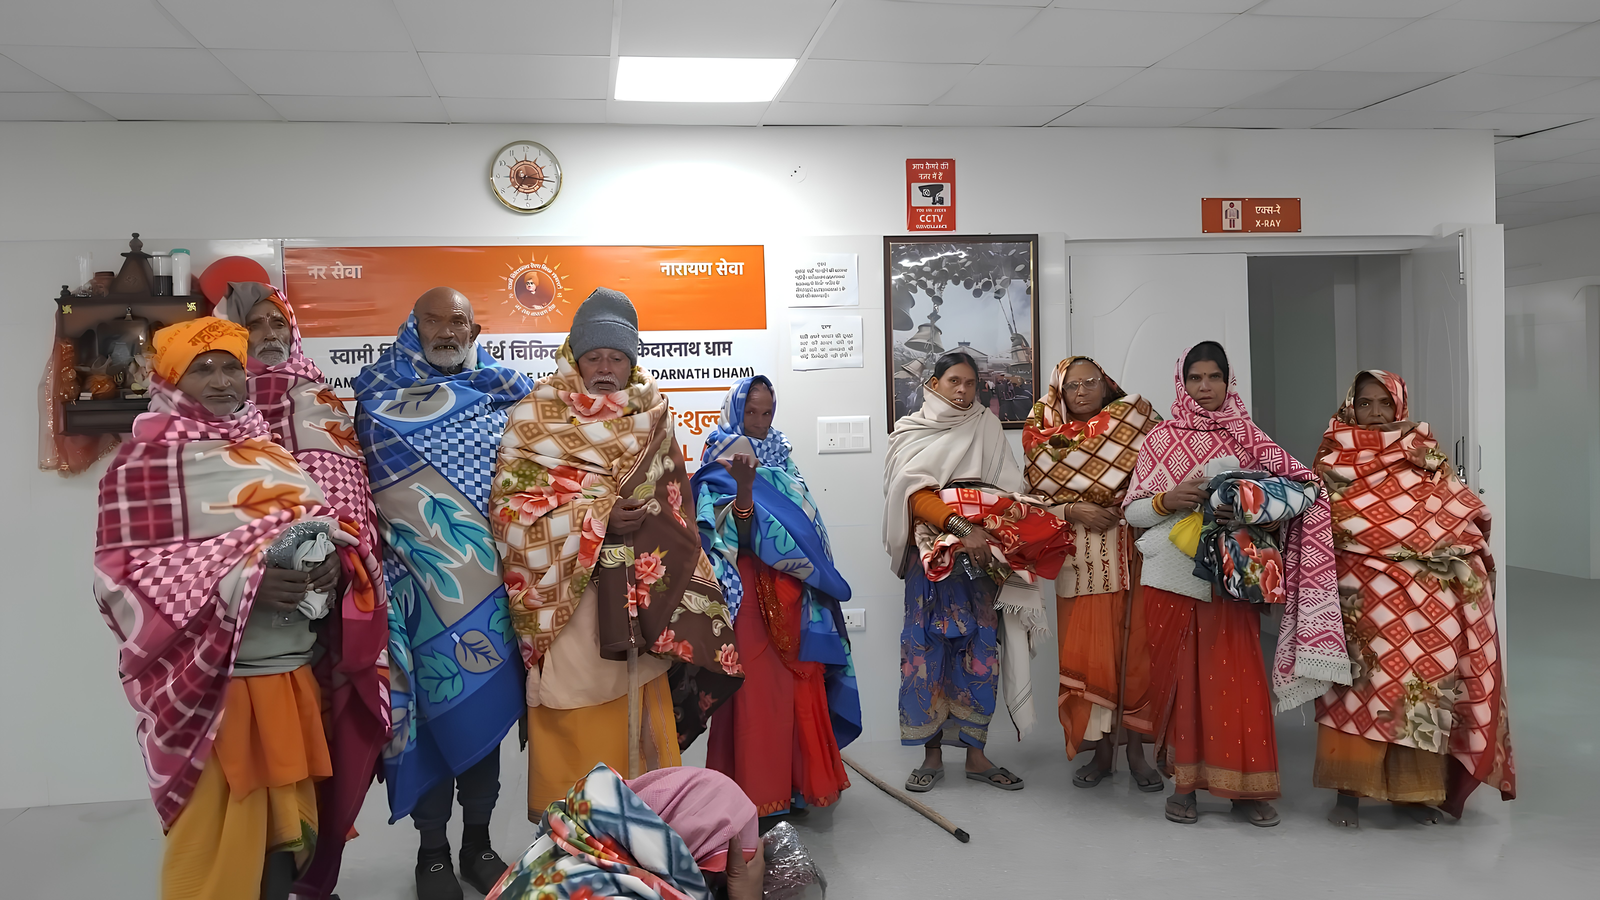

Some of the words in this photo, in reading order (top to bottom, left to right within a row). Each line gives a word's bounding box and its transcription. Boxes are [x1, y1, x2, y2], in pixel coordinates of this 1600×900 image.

[940, 162, 949, 170] की
[1255, 204, 1281, 214] एक्स-रे
[919, 214, 944, 223] CCTV
[1255, 219, 1281, 227] X-RAY
[307, 265, 328, 279] नर
[330, 261, 363, 279] सेवा
[659, 262, 713, 276] नारायण
[715, 257, 745, 276] सेवा
[329, 343, 374, 364] स्वामी
[637, 338, 701, 357] केदारनाथ
[704, 341, 733, 356] धाम
[713, 366, 755, 379] DHAM)
